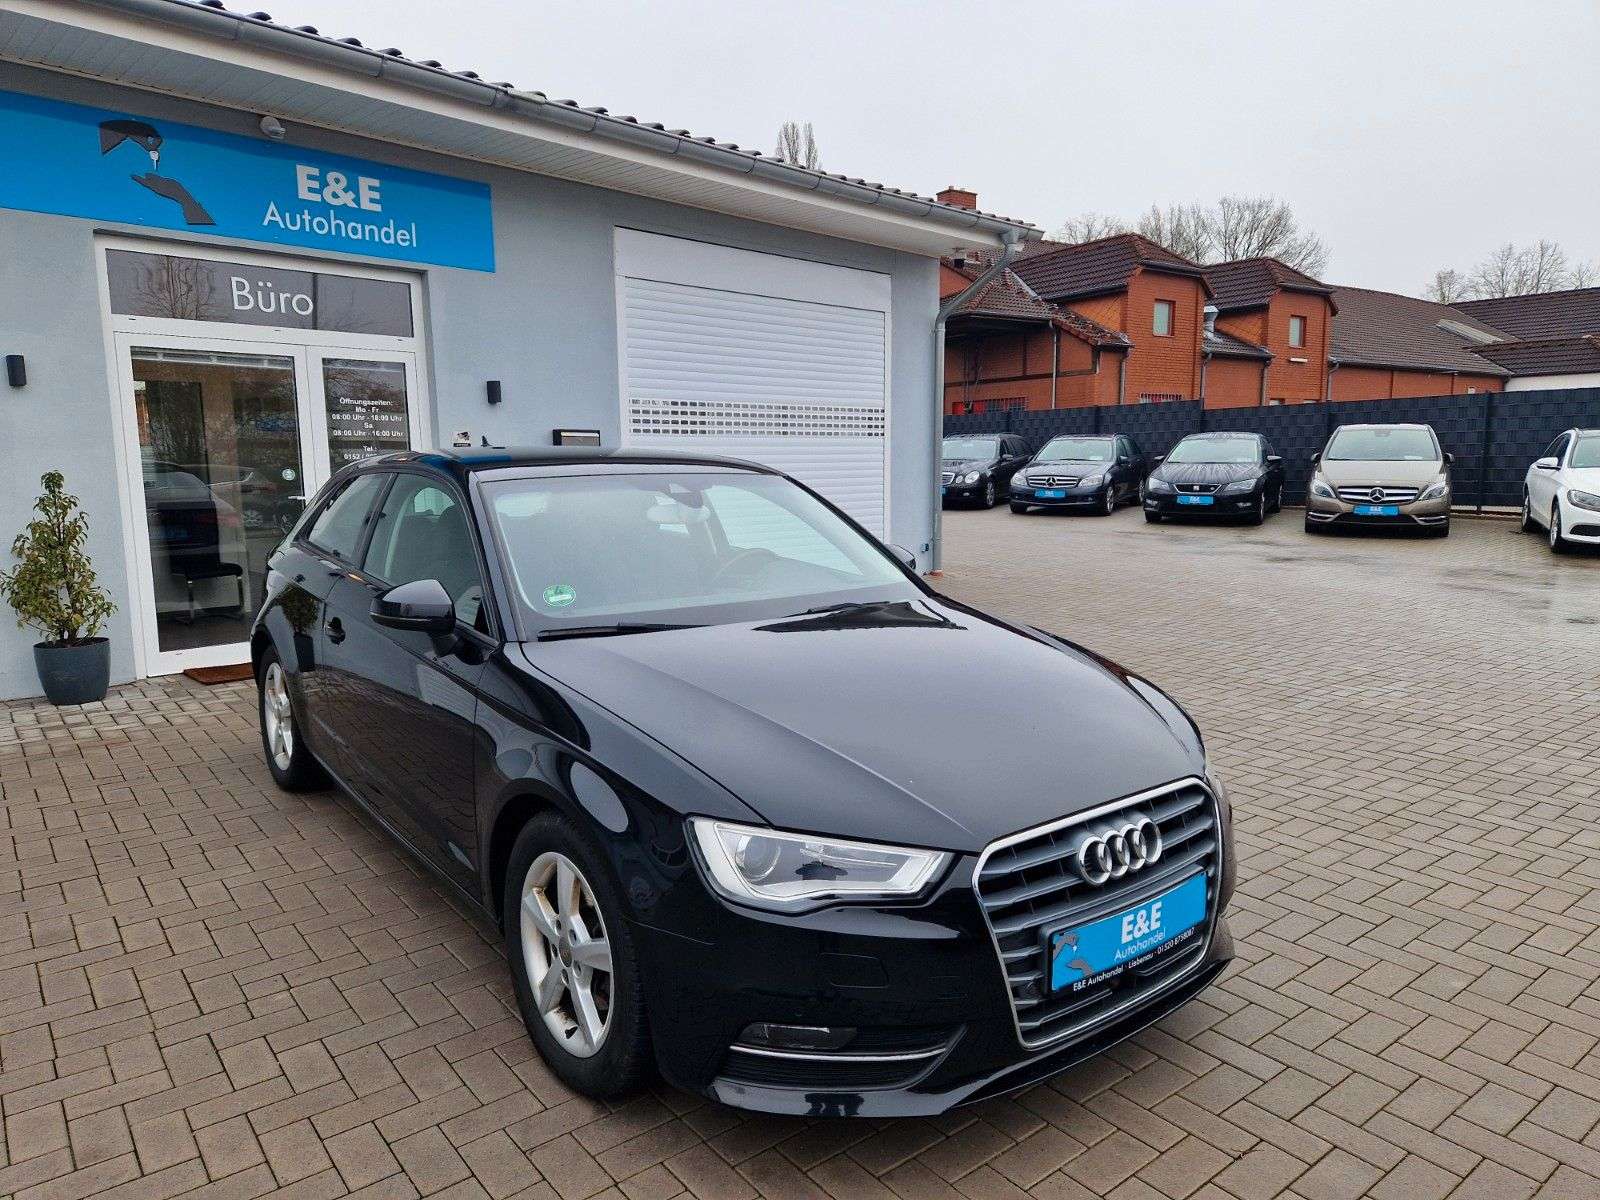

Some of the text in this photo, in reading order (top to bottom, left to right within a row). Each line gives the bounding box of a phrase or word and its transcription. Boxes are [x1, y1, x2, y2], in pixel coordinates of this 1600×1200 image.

[295, 164, 382, 212] E&E
[262, 201, 417, 248] Autohandel
[230, 276, 314, 315] Büro
[352, 413, 366, 421] Uhr
[363, 421, 374, 429] Sa
[1121, 901, 1162, 944] E&E
[1113, 928, 1166, 962] Autohandel
[1073, 979, 1087, 991] E&E
[1087, 963, 1124, 986] Autohandel
[1128, 952, 1154, 969] Liebenau
